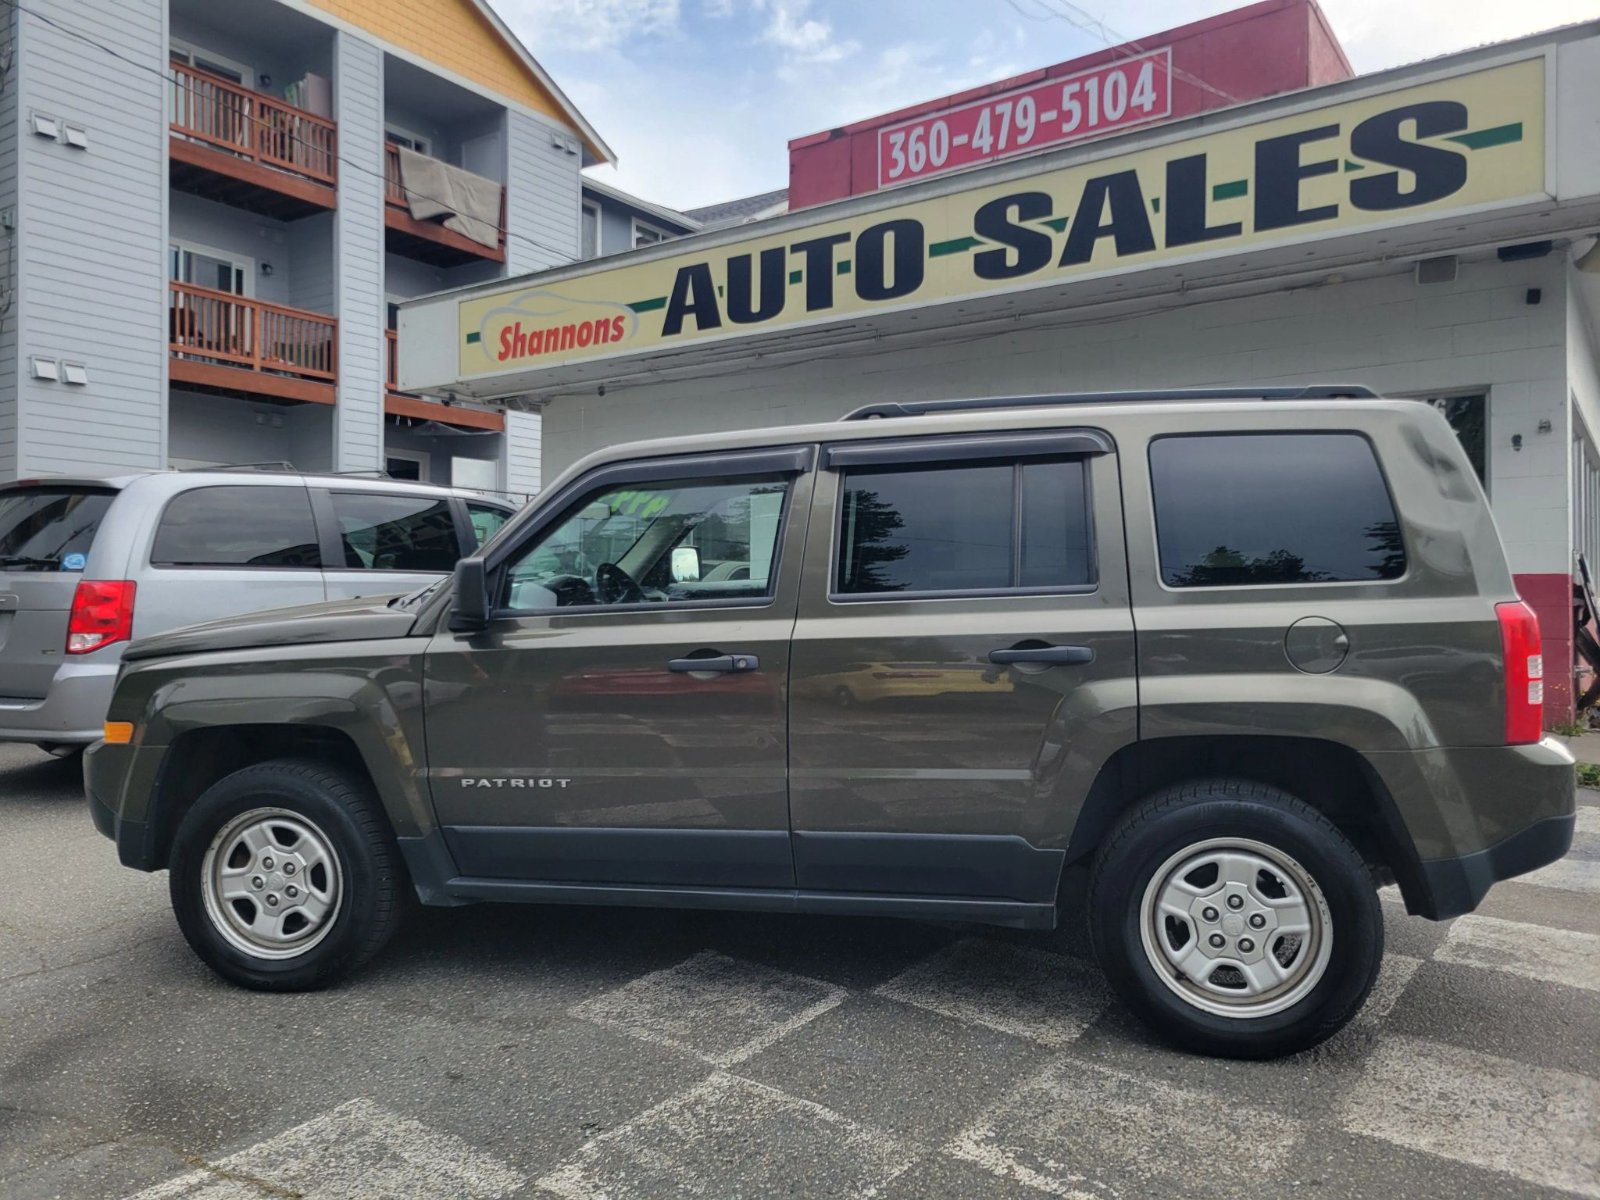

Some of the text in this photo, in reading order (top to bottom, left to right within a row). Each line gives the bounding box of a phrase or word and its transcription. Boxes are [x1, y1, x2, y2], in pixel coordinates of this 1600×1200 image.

[888, 62, 1156, 177] 360-479-5104
[661, 101, 1468, 337] AUTO SALES
[498, 315, 625, 361] Shannons
[460, 778, 571, 788] PATRIOT
